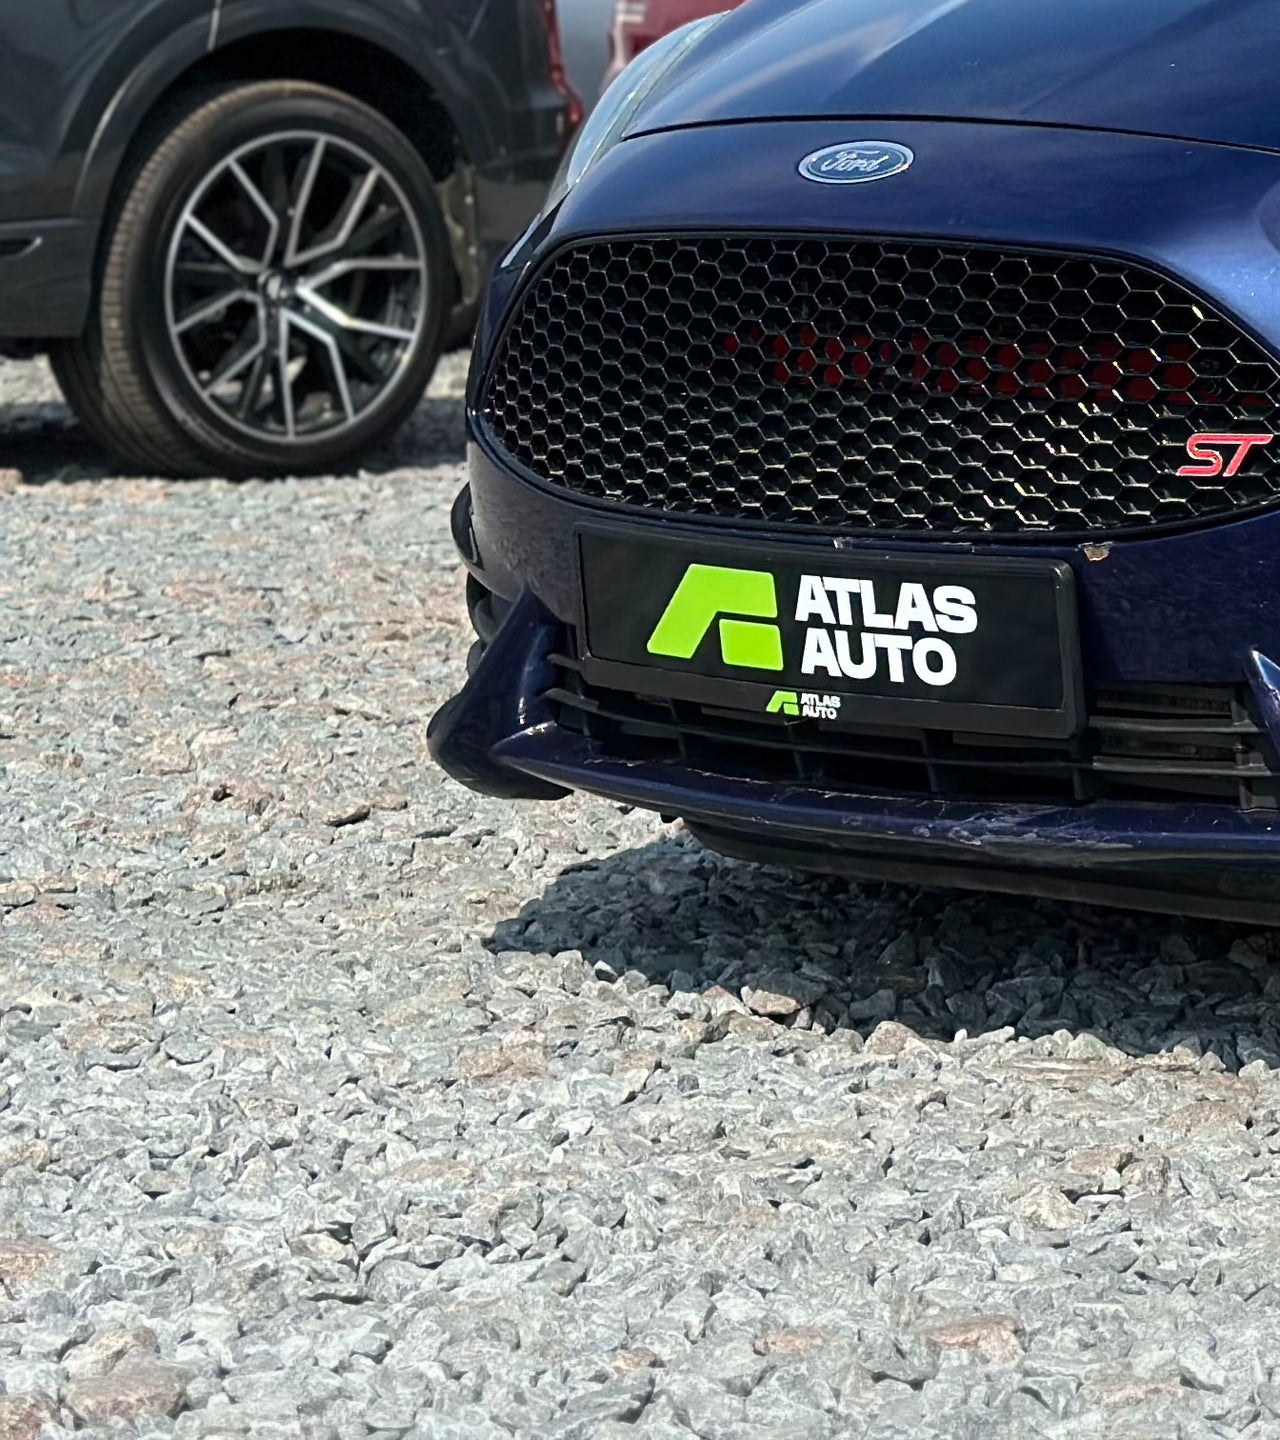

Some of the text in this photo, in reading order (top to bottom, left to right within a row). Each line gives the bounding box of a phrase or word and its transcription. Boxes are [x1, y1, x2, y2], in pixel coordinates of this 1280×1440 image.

[820, 149, 890, 172] Ford
[1175, 433, 1274, 476] ST
[795, 574, 978, 634] ATLAS
[801, 627, 957, 686] AUTO
[800, 692, 842, 708] ATLAS
[802, 705, 837, 719] AUTO
